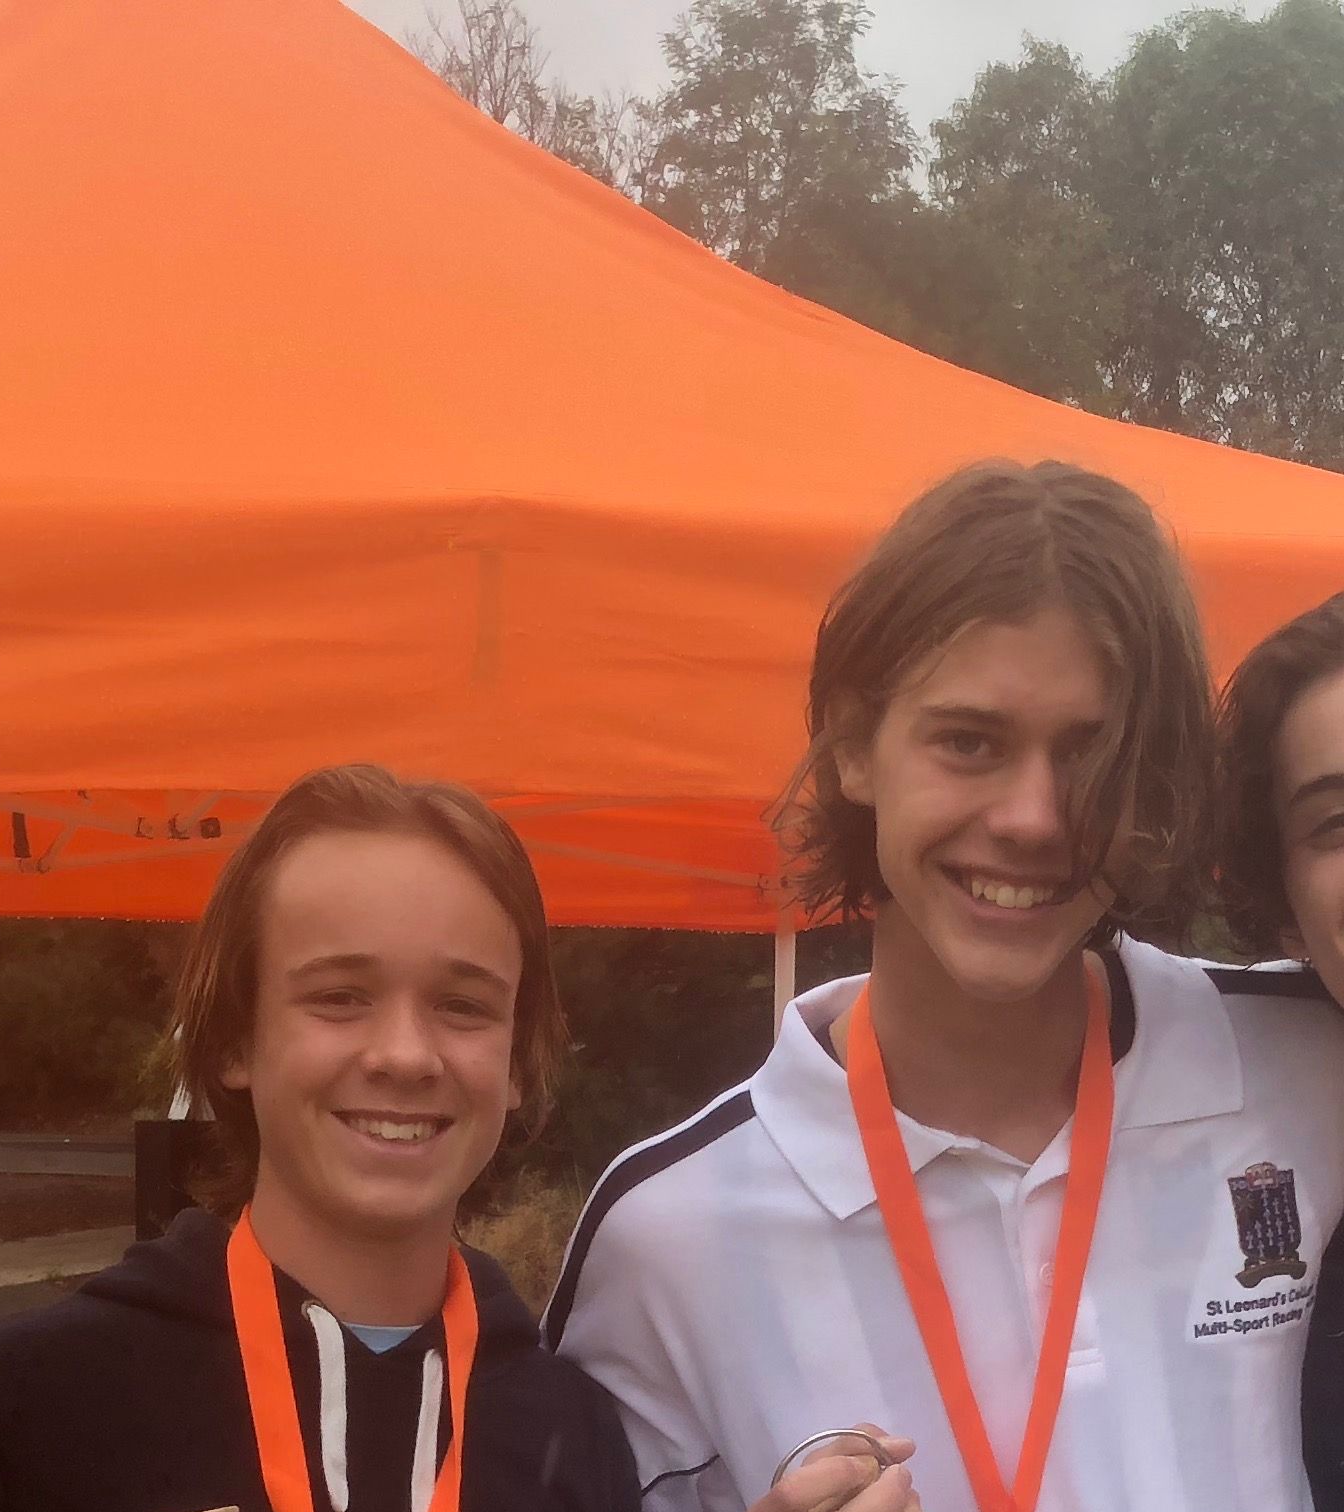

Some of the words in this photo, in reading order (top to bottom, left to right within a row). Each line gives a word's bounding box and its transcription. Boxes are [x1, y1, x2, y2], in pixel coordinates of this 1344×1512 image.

[1206, 1300, 1223, 1317] St
[1225, 1292, 1286, 1314] Leonard's
[1194, 1316, 1270, 1338] Multi-Sport
